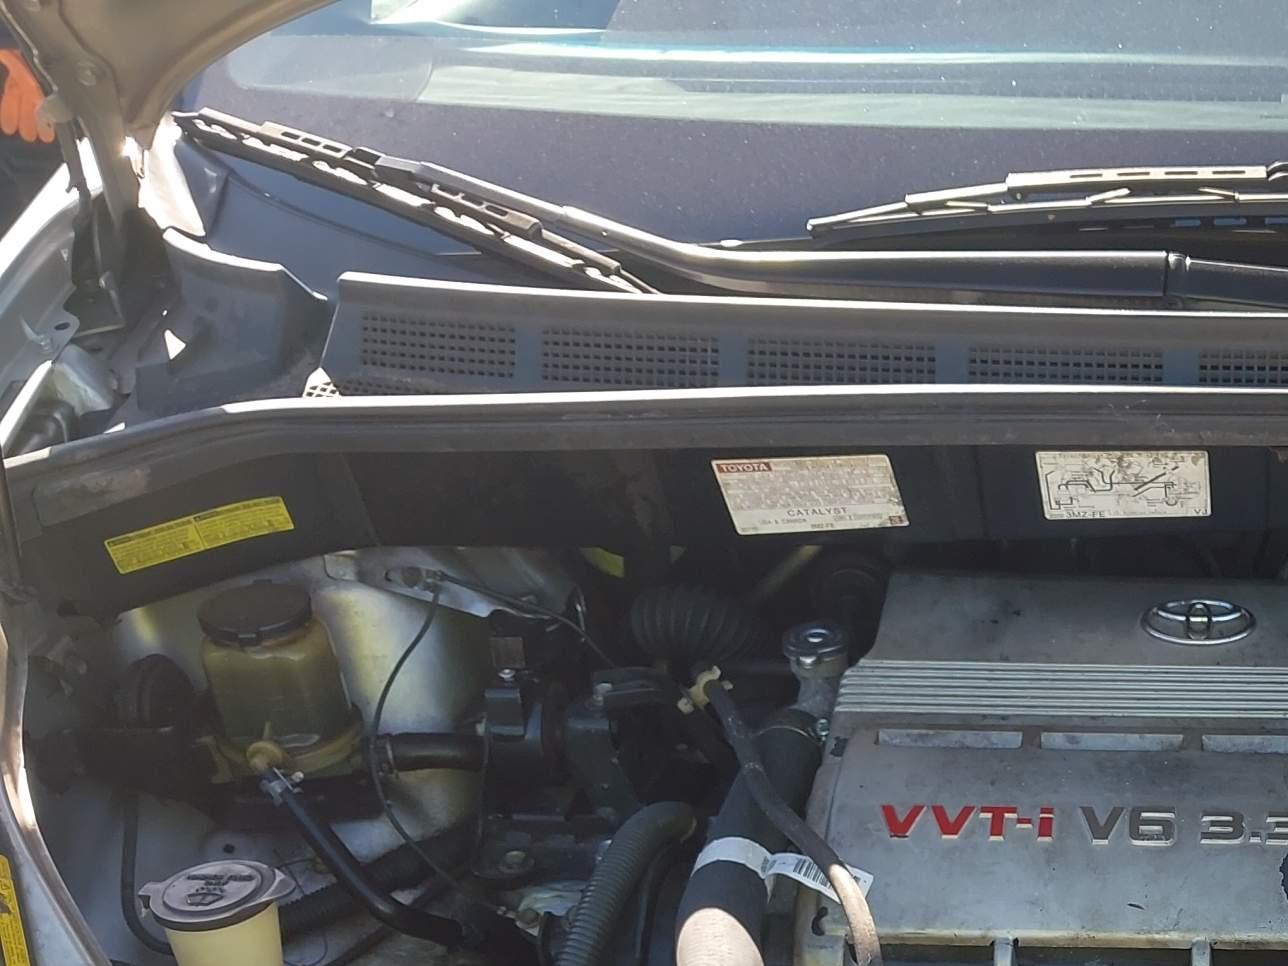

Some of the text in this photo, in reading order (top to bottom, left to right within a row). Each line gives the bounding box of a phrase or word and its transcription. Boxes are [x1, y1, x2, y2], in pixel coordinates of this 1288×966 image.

[720, 463, 768, 473] TOYOTA
[787, 506, 848, 517] CATALYST
[1066, 511, 1105, 519] 3MZ-FE
[881, 804, 1055, 841] VVT-i
[1079, 806, 1177, 846] V6
